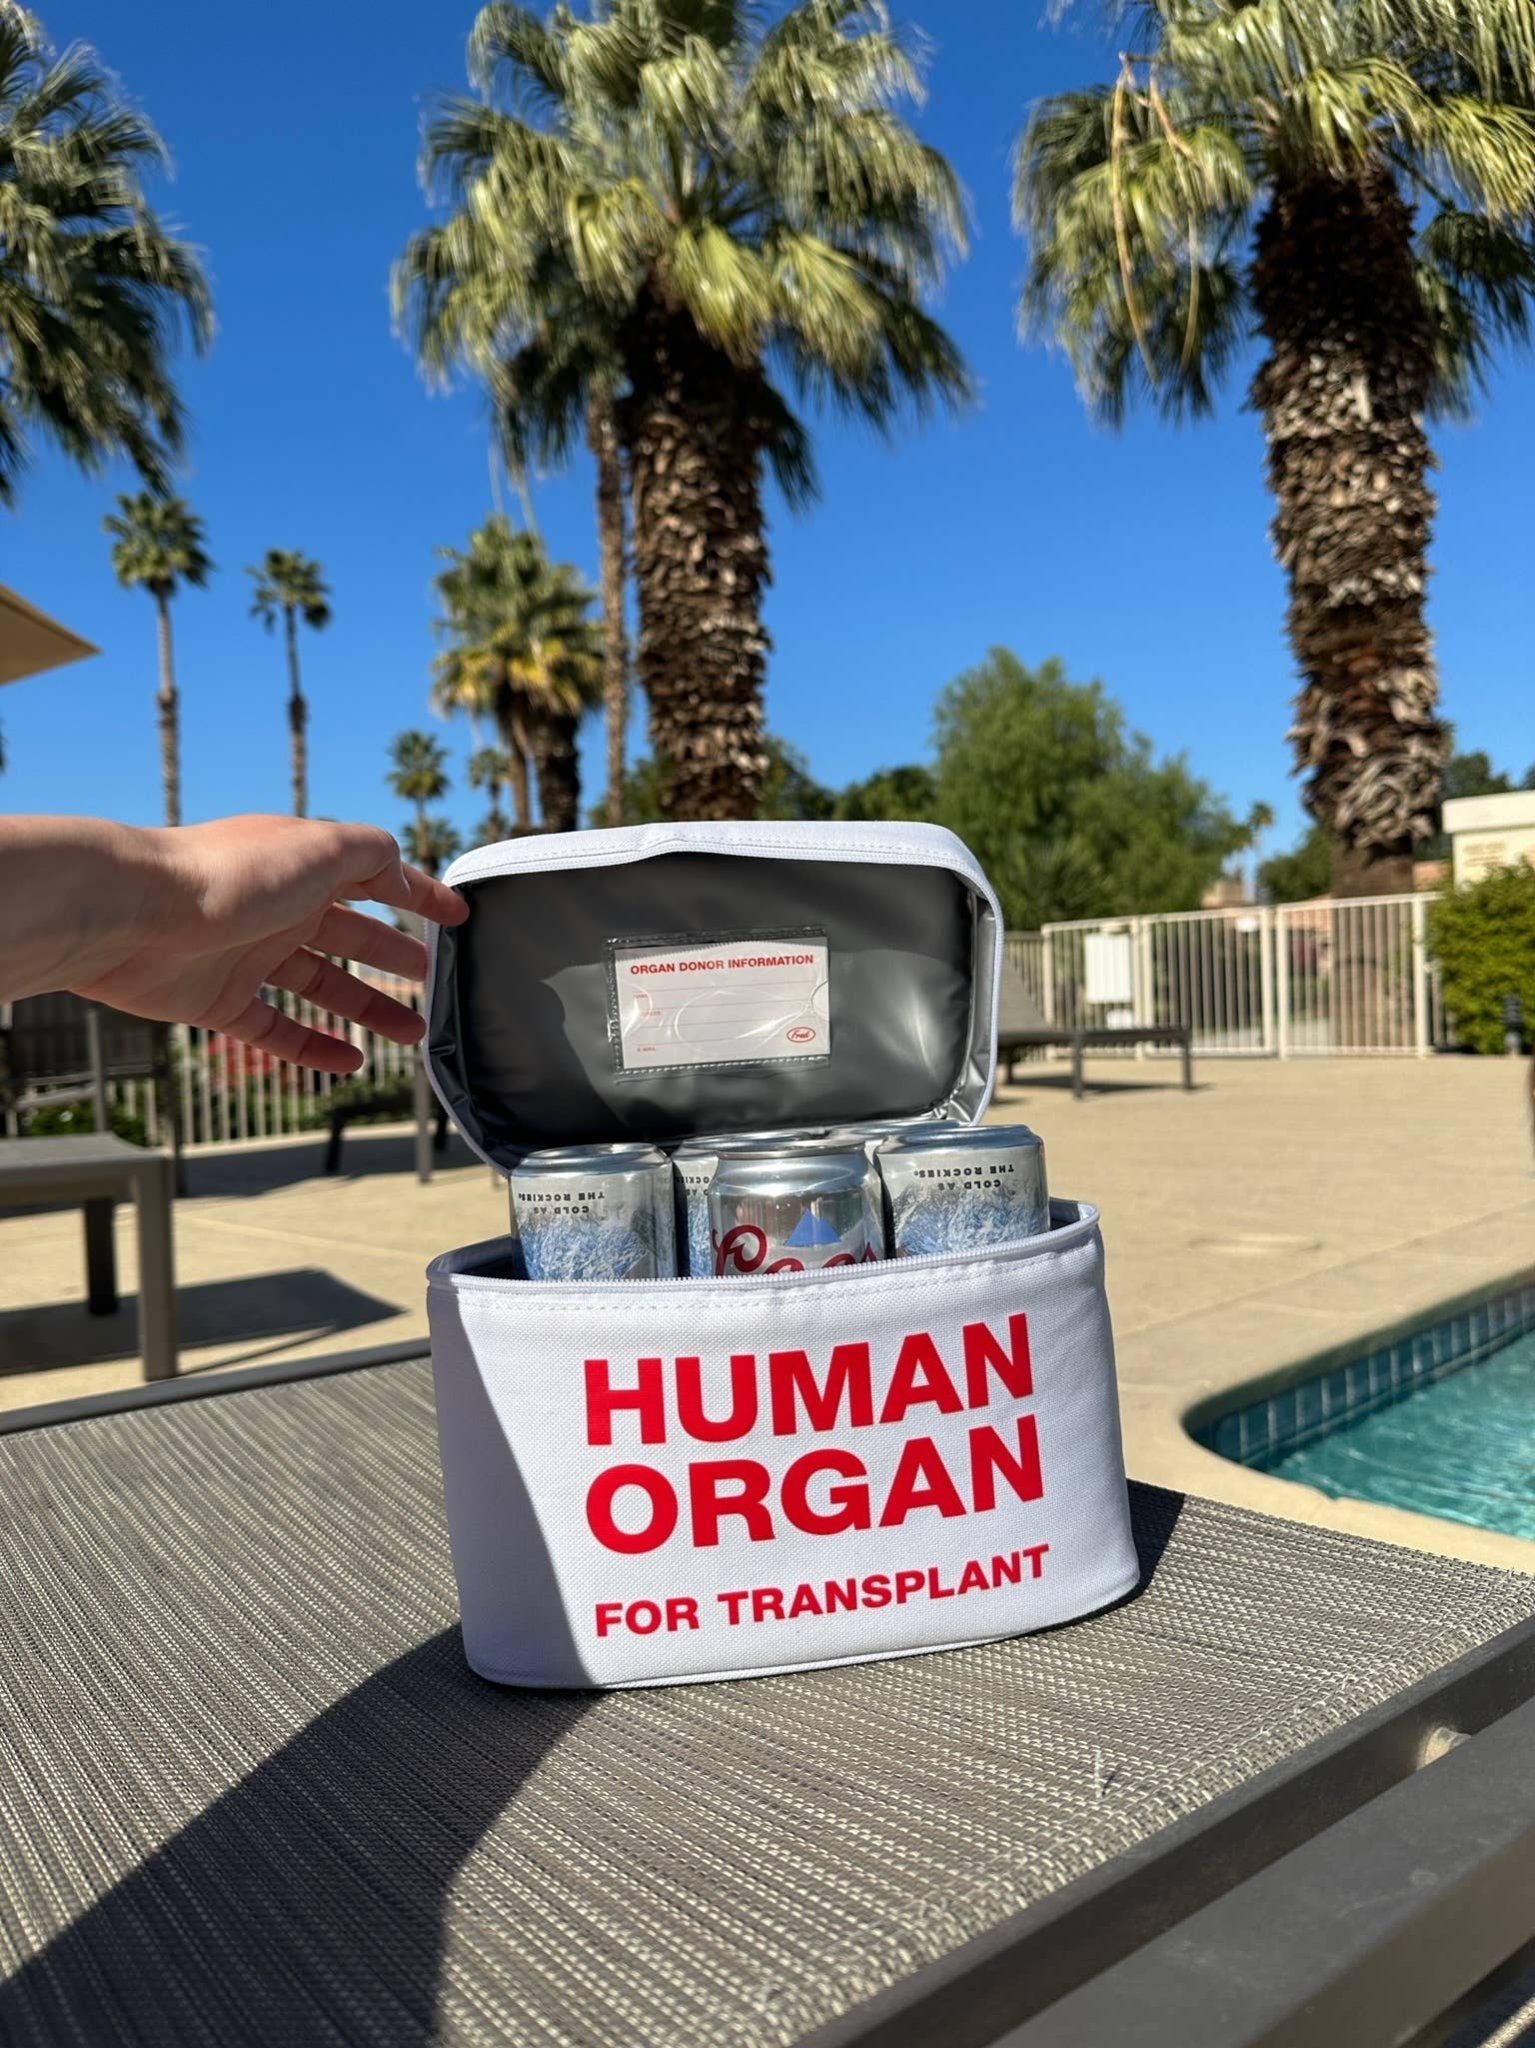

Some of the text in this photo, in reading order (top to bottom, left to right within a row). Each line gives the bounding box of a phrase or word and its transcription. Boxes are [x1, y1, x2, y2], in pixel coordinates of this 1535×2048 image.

[630, 954, 814, 975] ORGAN DONOR INFORMATION
[918, 1164, 1014, 1178] THE ROCKIES
[938, 1179, 1001, 1191] COLD AS
[521, 1192, 605, 1201] THE ROCKIES
[533, 1205, 590, 1215] COLD AS
[584, 1312, 1034, 1446] HUMAN
[586, 1413, 1044, 1555] ORGAN
[595, 1543, 1050, 1637] FOR TRANSPLANT
